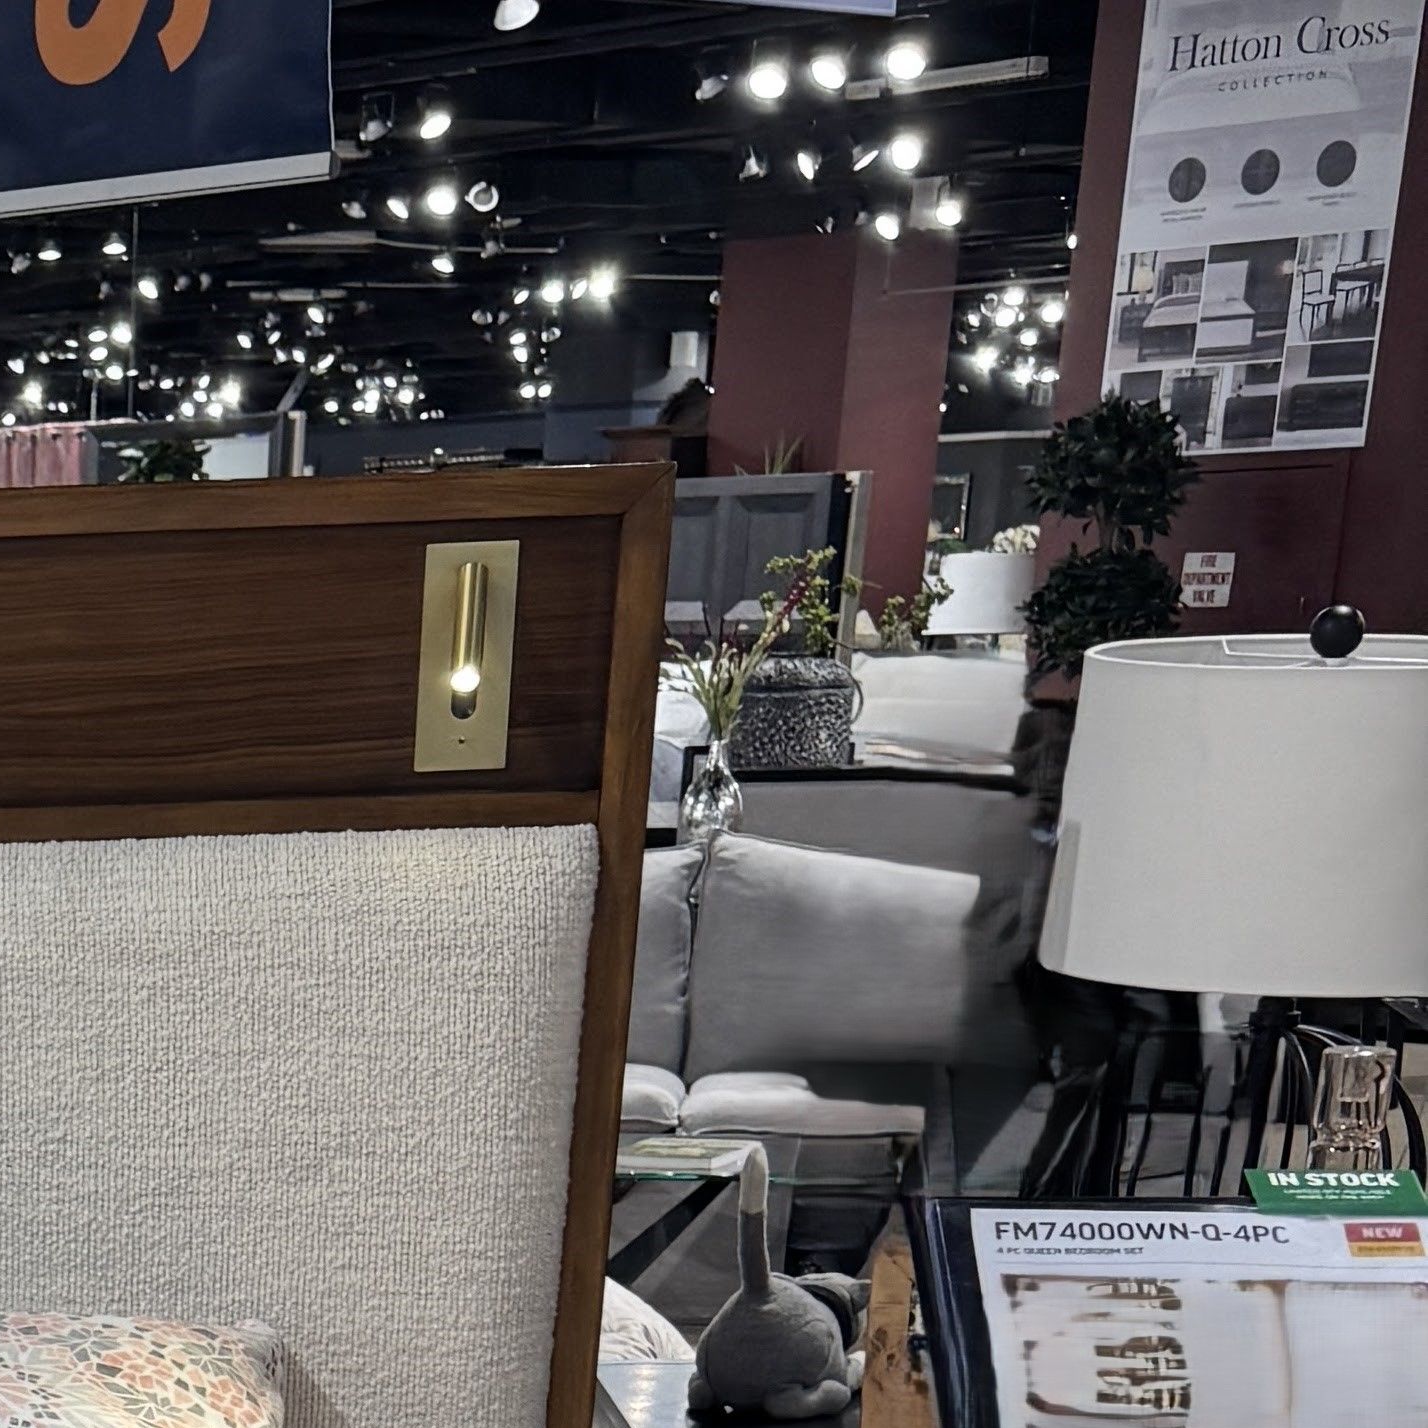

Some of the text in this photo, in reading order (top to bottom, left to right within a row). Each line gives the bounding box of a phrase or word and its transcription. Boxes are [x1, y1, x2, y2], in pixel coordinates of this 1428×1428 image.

[1168, 15, 1392, 73] Hatton Cross
[1217, 69, 1328, 93] COLLECTION
[1266, 1172, 1401, 1188] IN STOCK
[994, 1221, 1290, 1245] FM74000WN-Q-4PC
[1361, 1227, 1403, 1239] NEW
